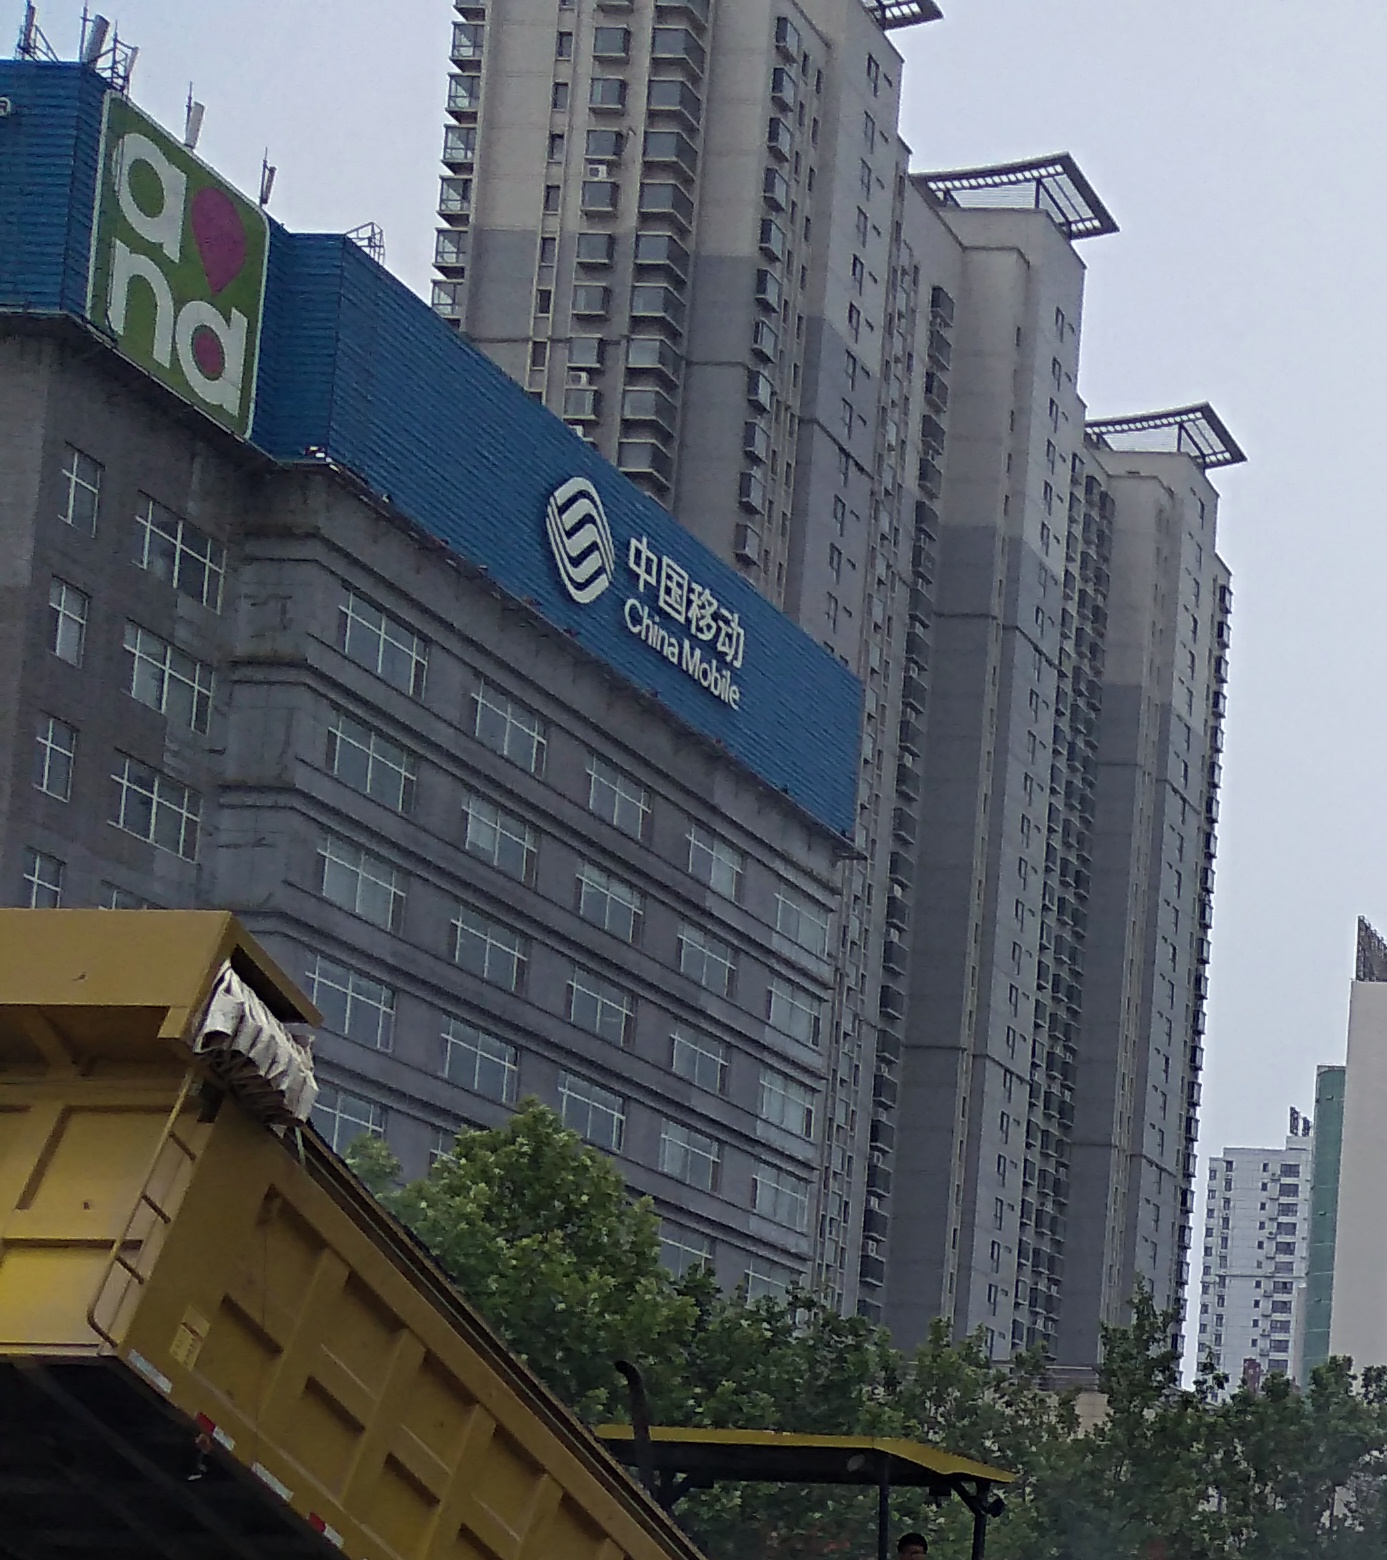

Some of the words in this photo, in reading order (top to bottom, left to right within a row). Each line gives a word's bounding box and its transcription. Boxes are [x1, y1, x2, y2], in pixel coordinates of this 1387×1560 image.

[624, 598, 679, 664] China
[682, 638, 740, 711] Mobile
[629, 535, 745, 669] 中国移动
